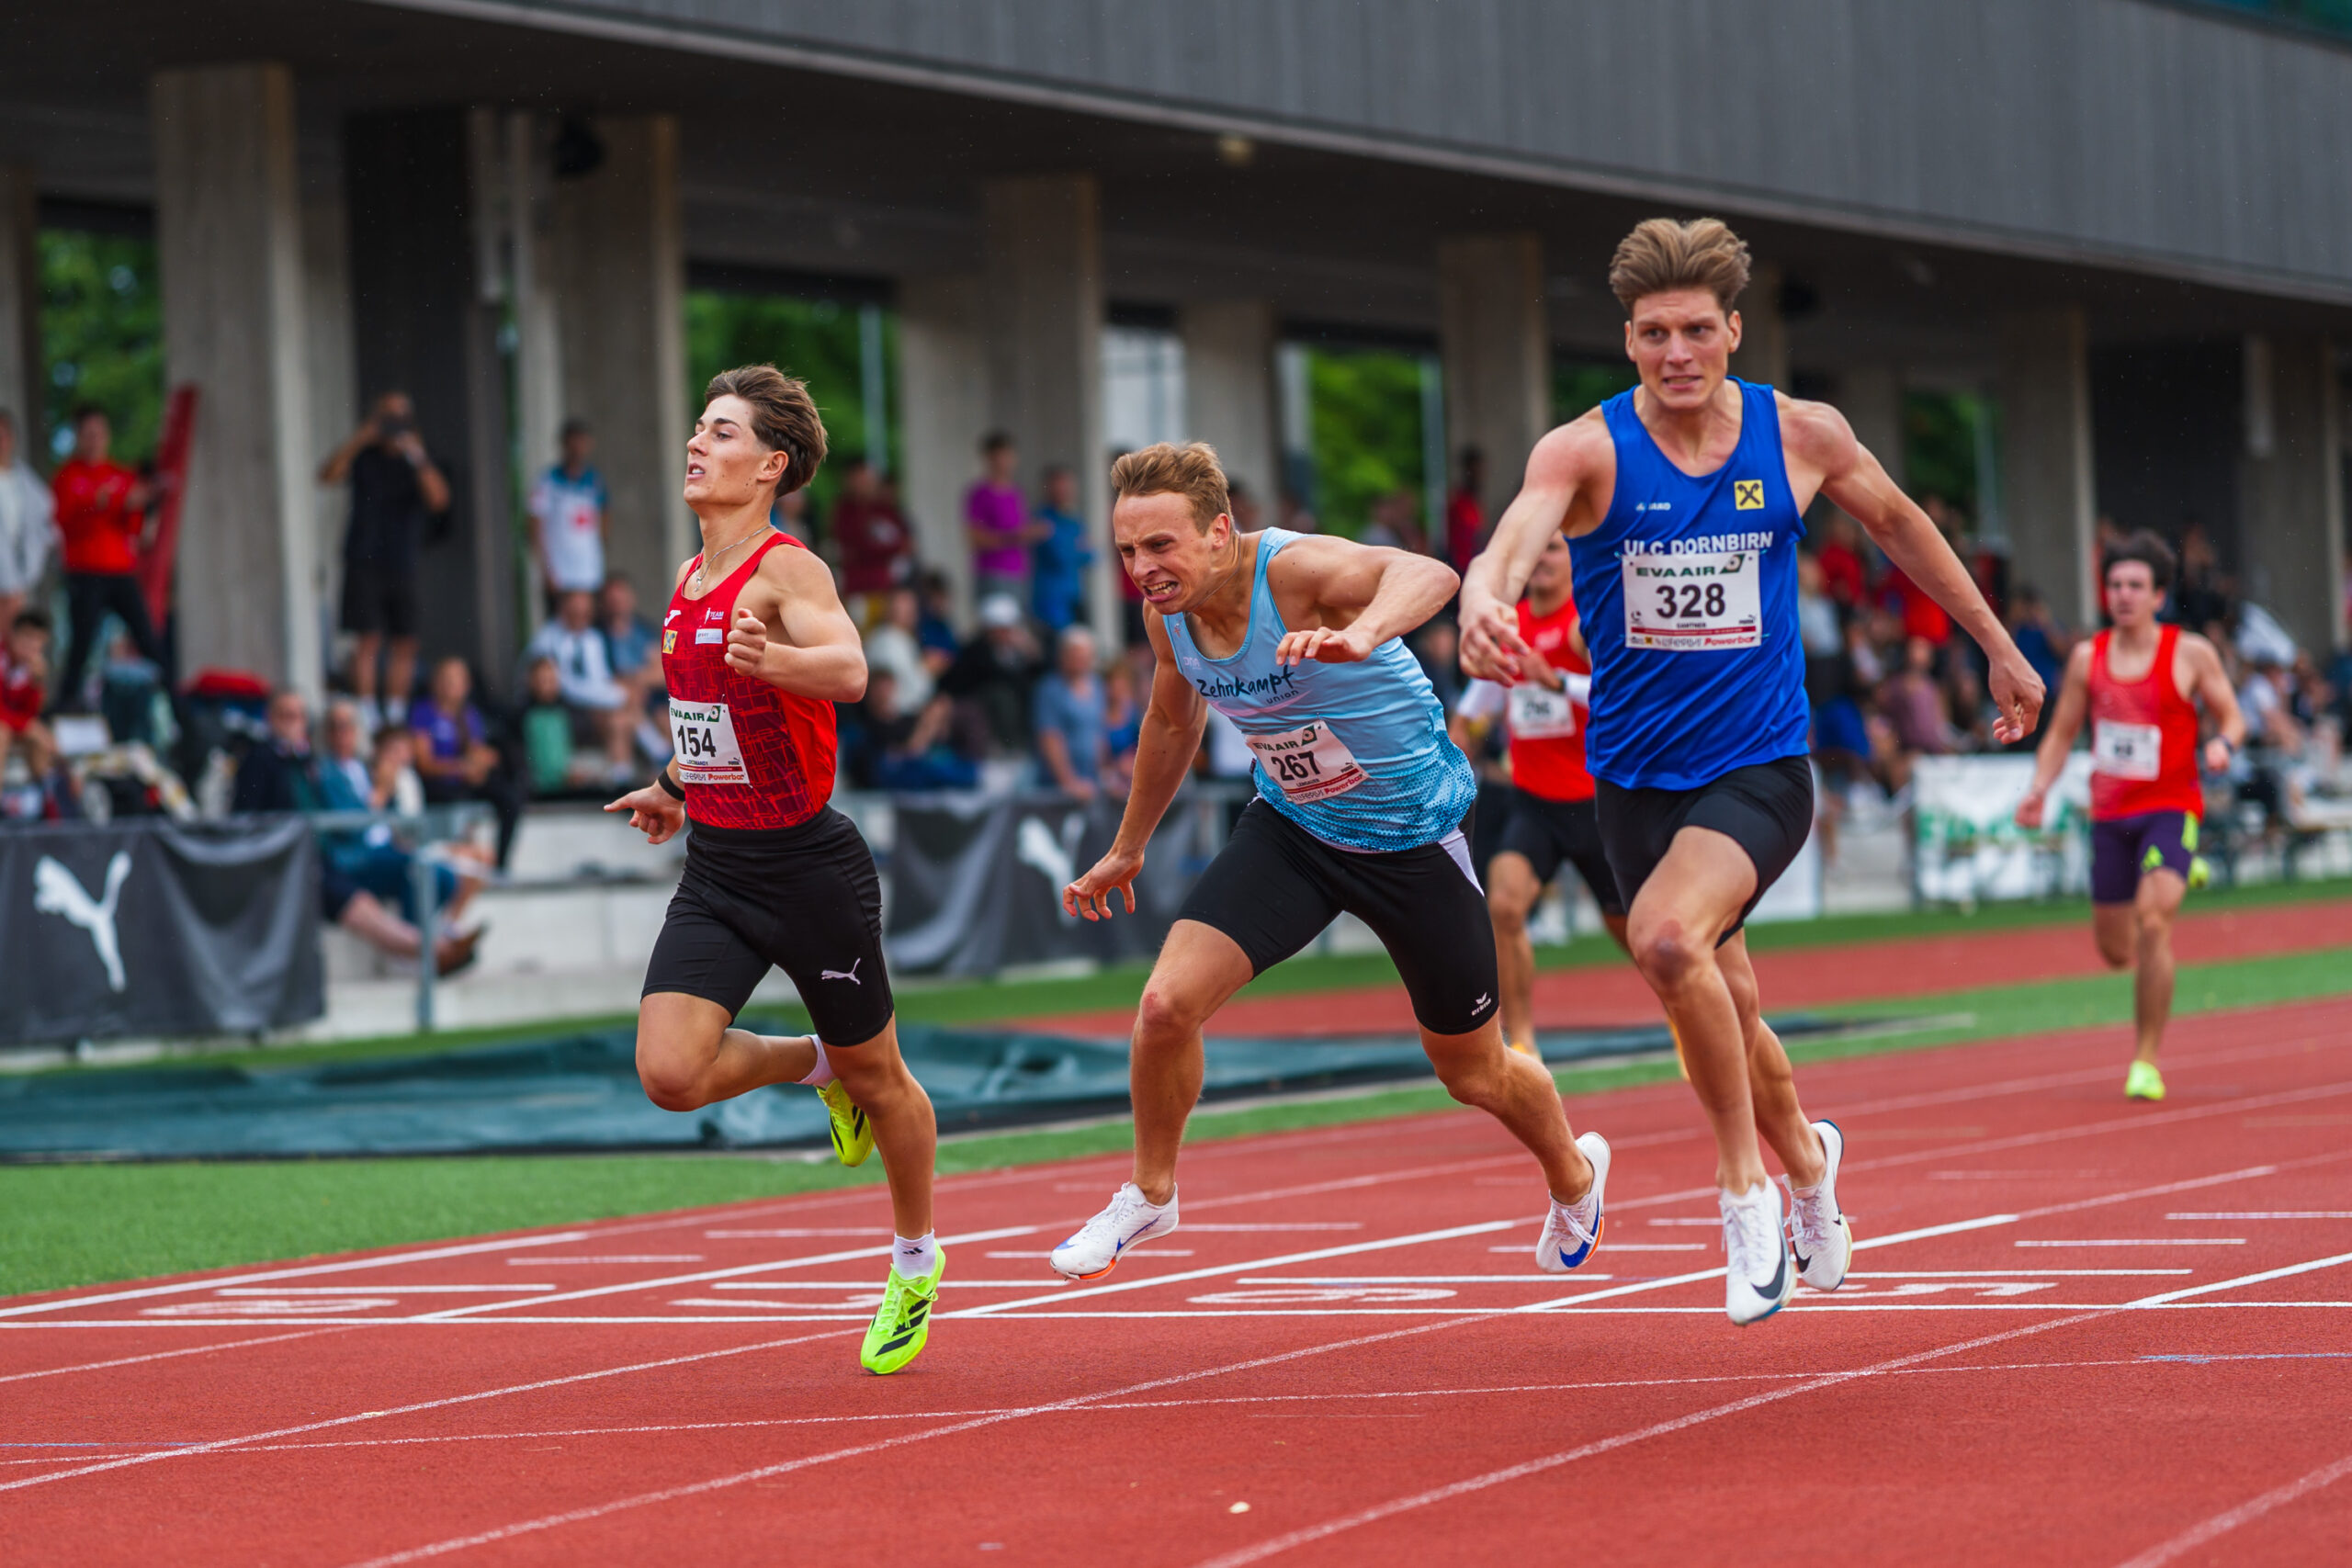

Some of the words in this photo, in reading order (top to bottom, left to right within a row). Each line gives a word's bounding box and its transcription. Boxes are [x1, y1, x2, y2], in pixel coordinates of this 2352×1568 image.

[1624, 538, 1665, 556] ULC
[1670, 531, 1774, 556] DORNBIRN
[1635, 567, 1677, 578] EVA
[1679, 566, 1716, 577] AIR
[1656, 583, 1725, 618] 328
[1196, 664, 1295, 698] Zehnkampf
[1266, 690, 1300, 705] union
[671, 708, 684, 721] EVA
[684, 711, 705, 722] AIR
[677, 724, 717, 758] 154
[1253, 742, 1275, 752] EVA
[1275, 740, 1299, 750] AIR
[1271, 750, 1320, 781] 267
[1324, 773, 1363, 795] Powerbar
